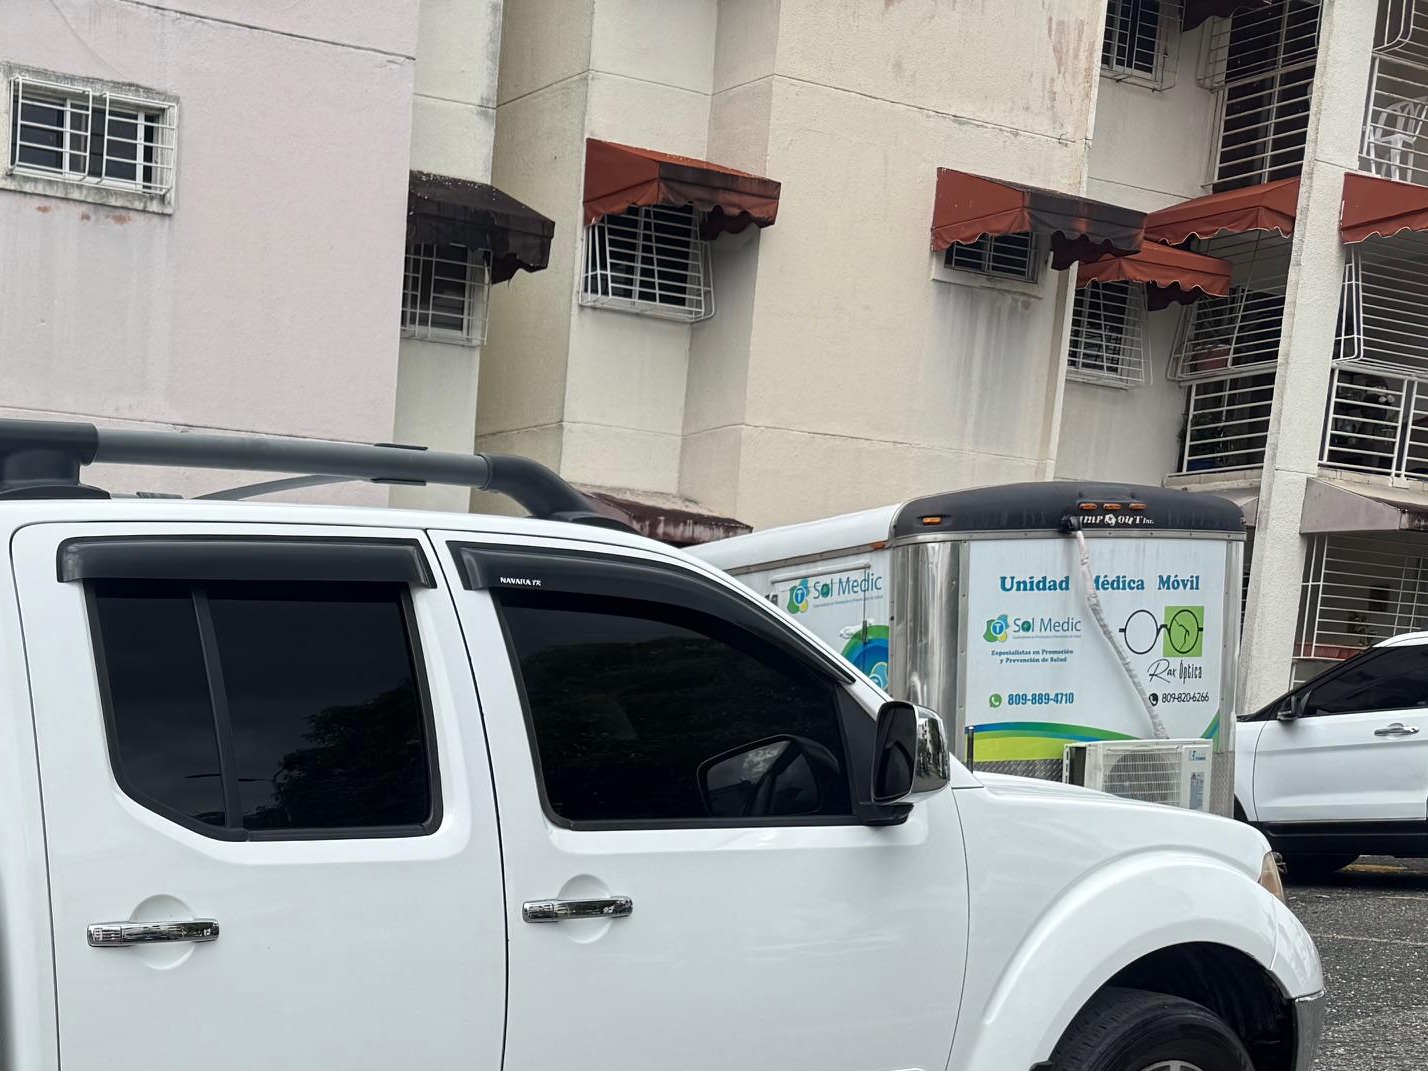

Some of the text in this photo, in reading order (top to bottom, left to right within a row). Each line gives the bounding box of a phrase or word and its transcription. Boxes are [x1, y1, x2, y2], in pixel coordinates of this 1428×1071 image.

[500, 577, 531, 586] NAVARA
[813, 572, 883, 600] Sol Medic
[999, 576, 1070, 592] Unidad
[1157, 573, 1200, 591] Móvil
[1012, 616, 1082, 633] Sol Medic
[991, 649, 1032, 657] Especialistas
[1041, 648, 1074, 656] Promoción
[1005, 656, 1040, 664] Prevención
[1178, 659, 1203, 685] Óptica
[1007, 692, 1075, 706] 809-889-4710
[1161, 692, 1210, 704] 809-820-6266
